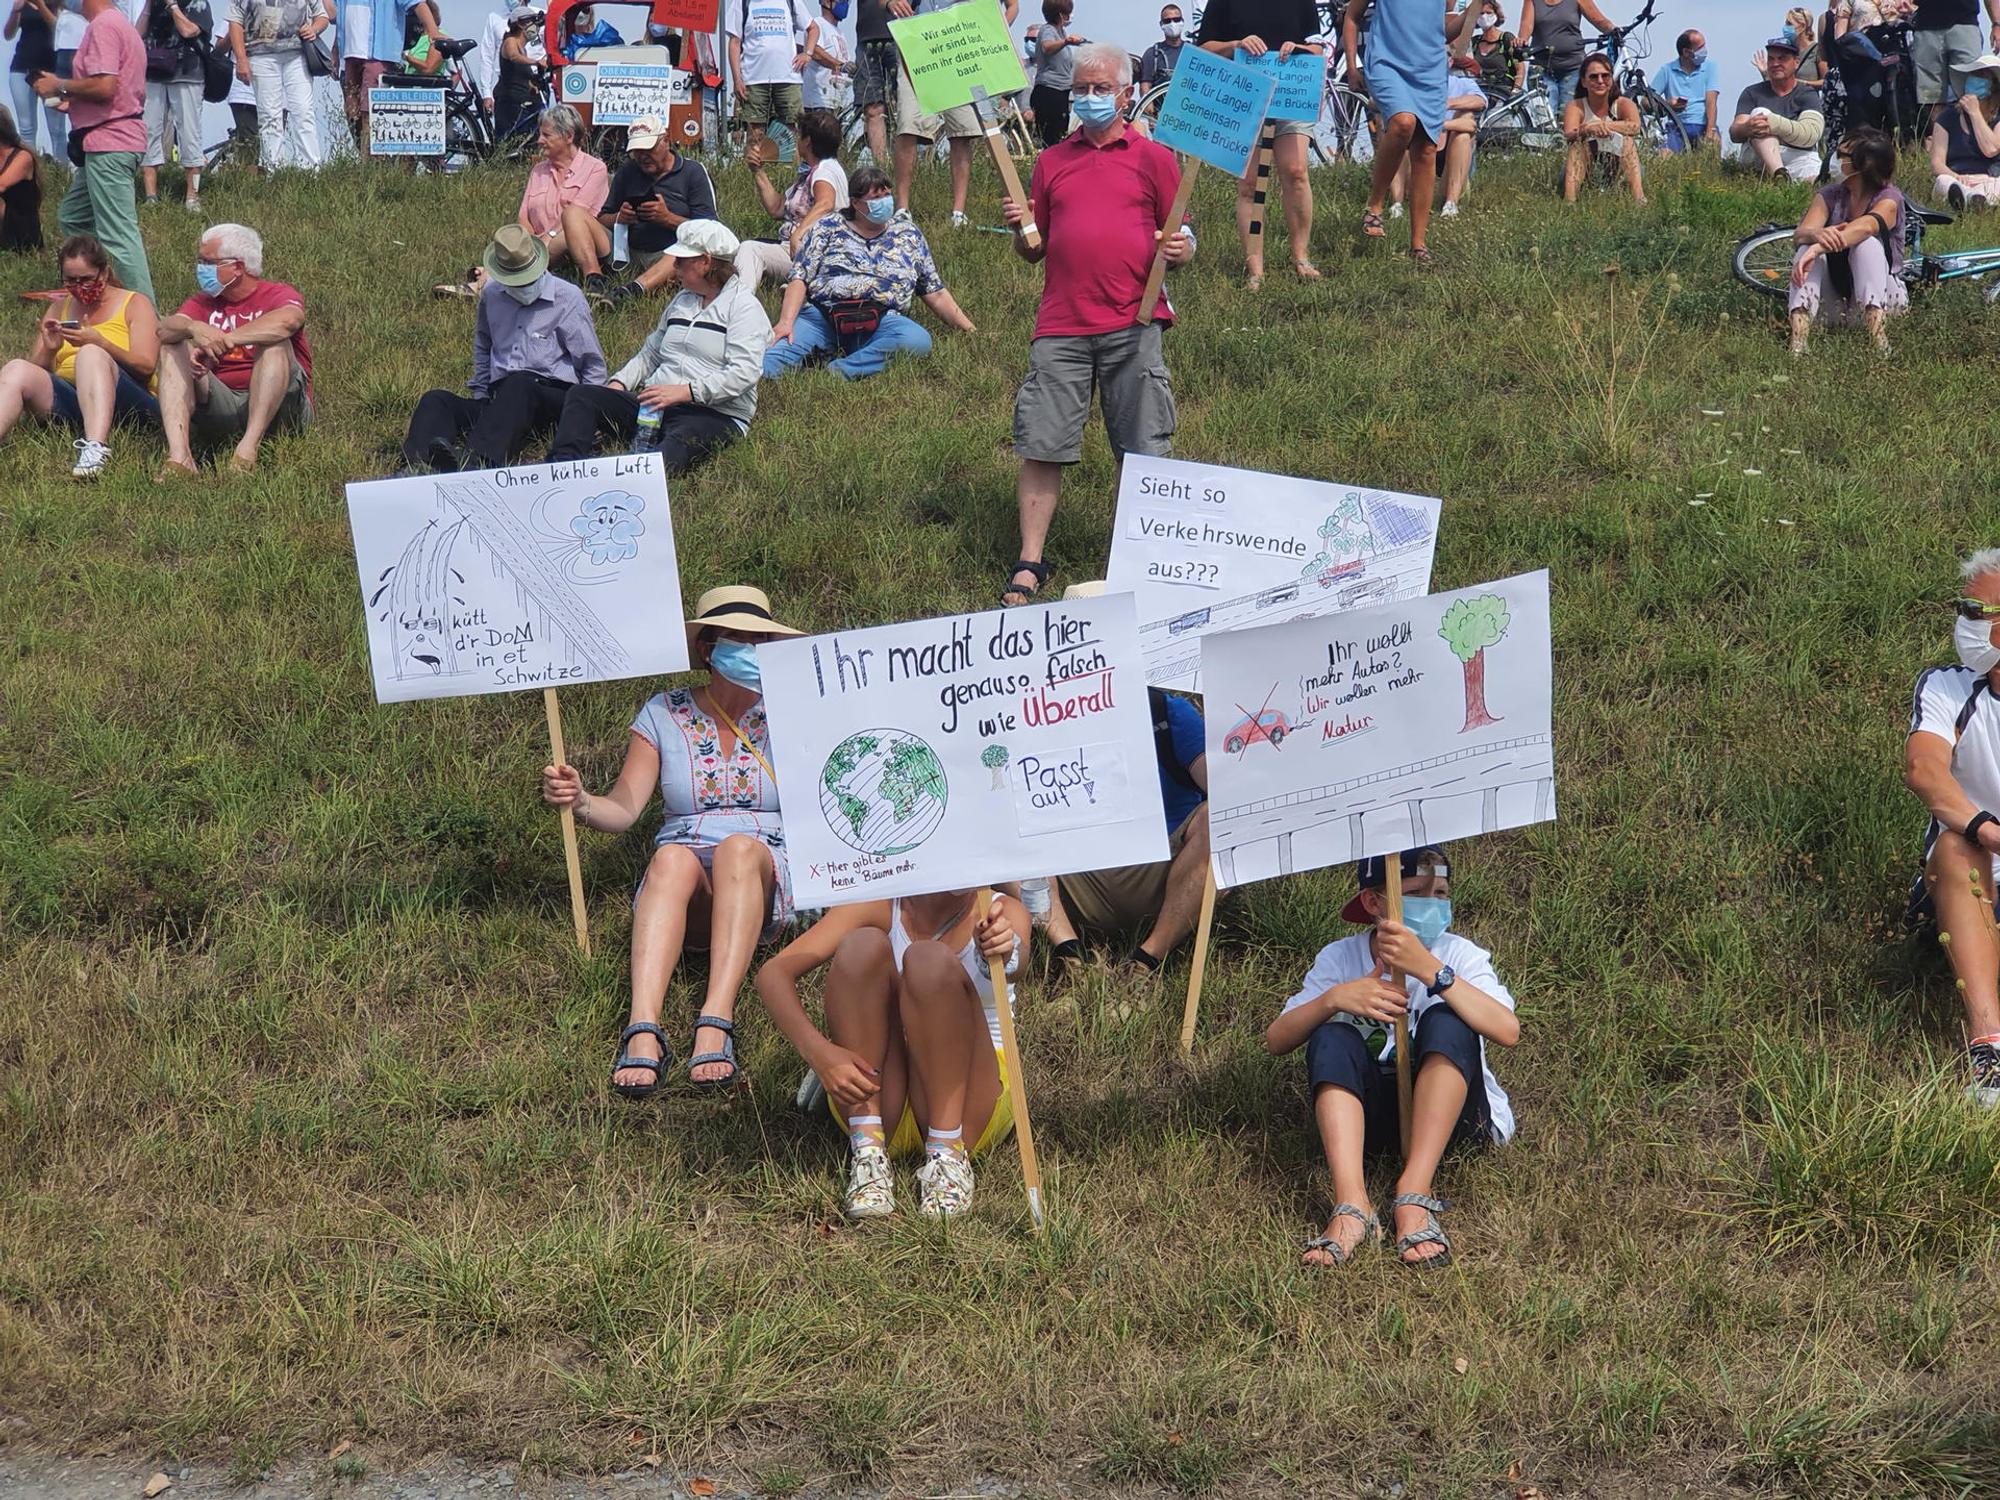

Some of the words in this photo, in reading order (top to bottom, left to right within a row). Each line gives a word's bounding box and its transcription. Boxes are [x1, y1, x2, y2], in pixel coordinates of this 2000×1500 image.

[921, 30, 939, 42] Wir
[941, 23, 962, 36] sind
[962, 20, 981, 32] hier,
[929, 44, 944, 55] wir
[945, 37, 967, 50] sind
[601, 66, 627, 76] OBEN
[629, 66, 669, 78] BLEIBEN
[912, 61, 939, 76] wenn
[940, 56, 954, 68] ihr
[955, 49, 981, 63] diese
[980, 43, 1009, 57] Brücke
[956, 63, 982, 77] baut.
[1290, 60, 1309, 69] Alle
[1188, 56, 1218, 78] Einer
[1217, 66, 1232, 84] für
[1232, 75, 1253, 93] Alle
[372, 92, 399, 100] OBEN
[401, 92, 441, 100] BLEIBEN
[1180, 76, 1199, 93] alle
[1200, 84, 1216, 102] für
[1180, 97, 1241, 132] Gemeinsam
[1285, 98, 1319, 110] Brücke
[1162, 113, 1191, 133] gegen
[1193, 125, 1209, 141] die
[1210, 133, 1249, 157] Brücke
[495, 469, 539, 488] Ohne
[551, 461, 599, 482] kühle
[615, 457, 652, 477] Luft
[1139, 476, 1193, 500] Sieht
[1202, 487, 1226, 504] so
[1148, 561, 1219, 582] aus???
[453, 608, 488, 629] kütt
[476, 652, 495, 667] in
[503, 644, 528, 664] et
[812, 638, 874, 698] Ihr
[888, 618, 973, 682] macht
[988, 612, 1033, 660] das
[1045, 611, 1091, 651] hier
[1328, 640, 1358, 666] Ihr
[1366, 620, 1412, 654] wollt
[493, 662, 584, 685] Schwitze
[1306, 665, 1344, 692] mehr
[1352, 651, 1402, 680] Autos?
[941, 674, 1030, 734] genauso
[1045, 649, 1107, 691] falsch
[1307, 694, 1329, 714] Wir
[1335, 683, 1377, 706] wollen
[1388, 668, 1424, 691] mehr
[978, 712, 1016, 737] wie
[1322, 714, 1374, 741] Natur
[1017, 747, 1090, 791] Passt
[875, 855, 887, 864] es
[831, 876, 856, 888] keine
